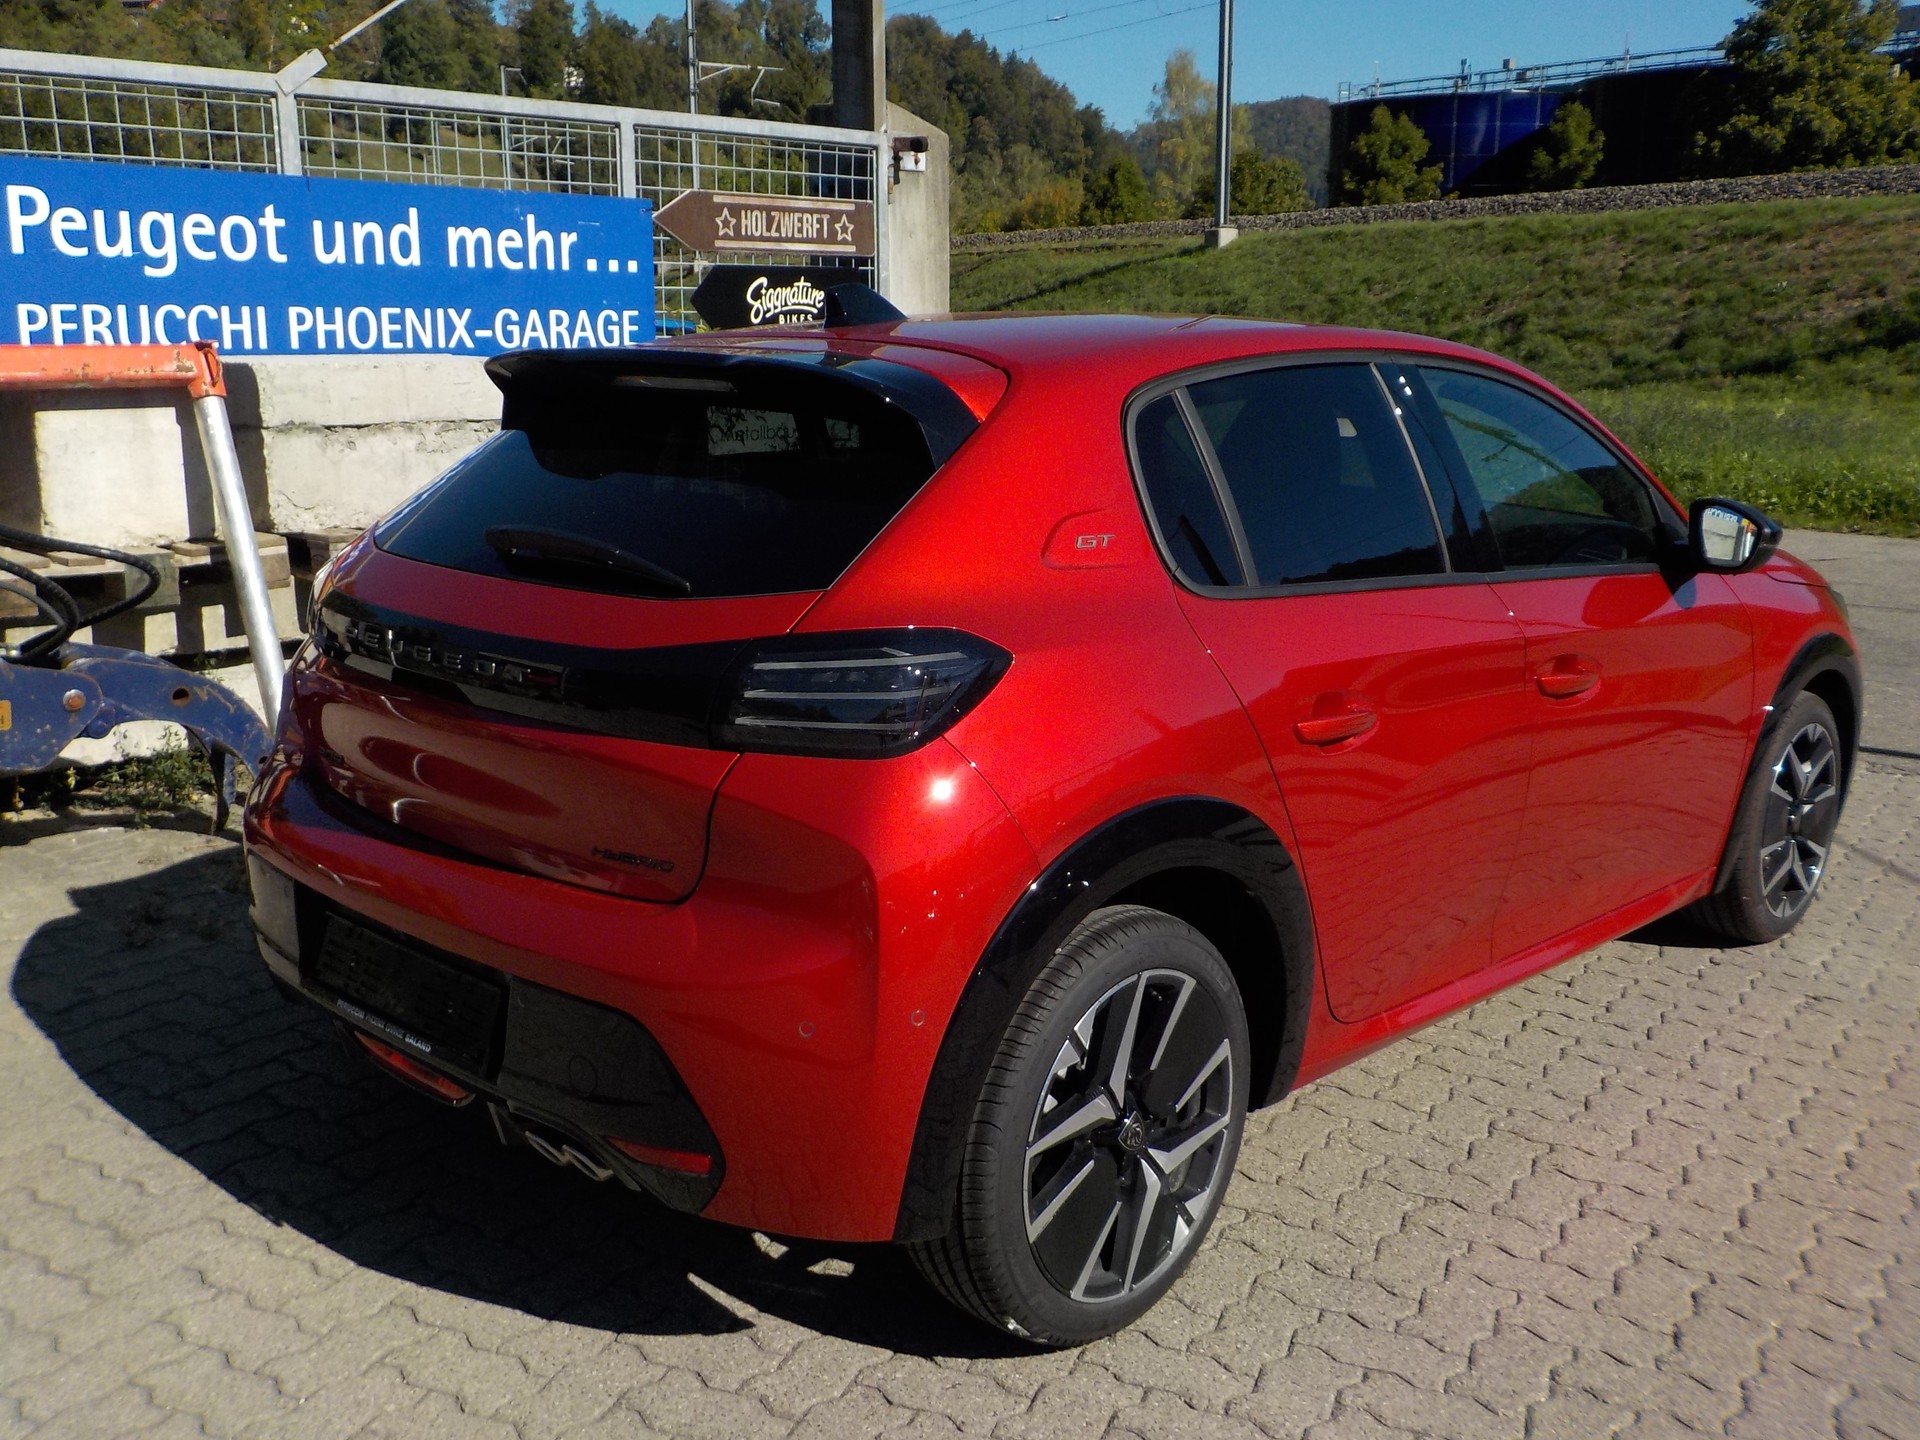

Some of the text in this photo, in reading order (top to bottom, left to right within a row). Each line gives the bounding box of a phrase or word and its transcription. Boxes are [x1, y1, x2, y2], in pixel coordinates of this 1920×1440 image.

[6, 185, 638, 278] Peugeot und mehr...
[741, 209, 830, 239] HOLZWERFT
[17, 303, 639, 349] PERUCCHI PHOENIX-GARAGE
[779, 314, 813, 325] BIKES
[1075, 534, 1116, 550] GT
[346, 623, 532, 683] PEUGEOT
